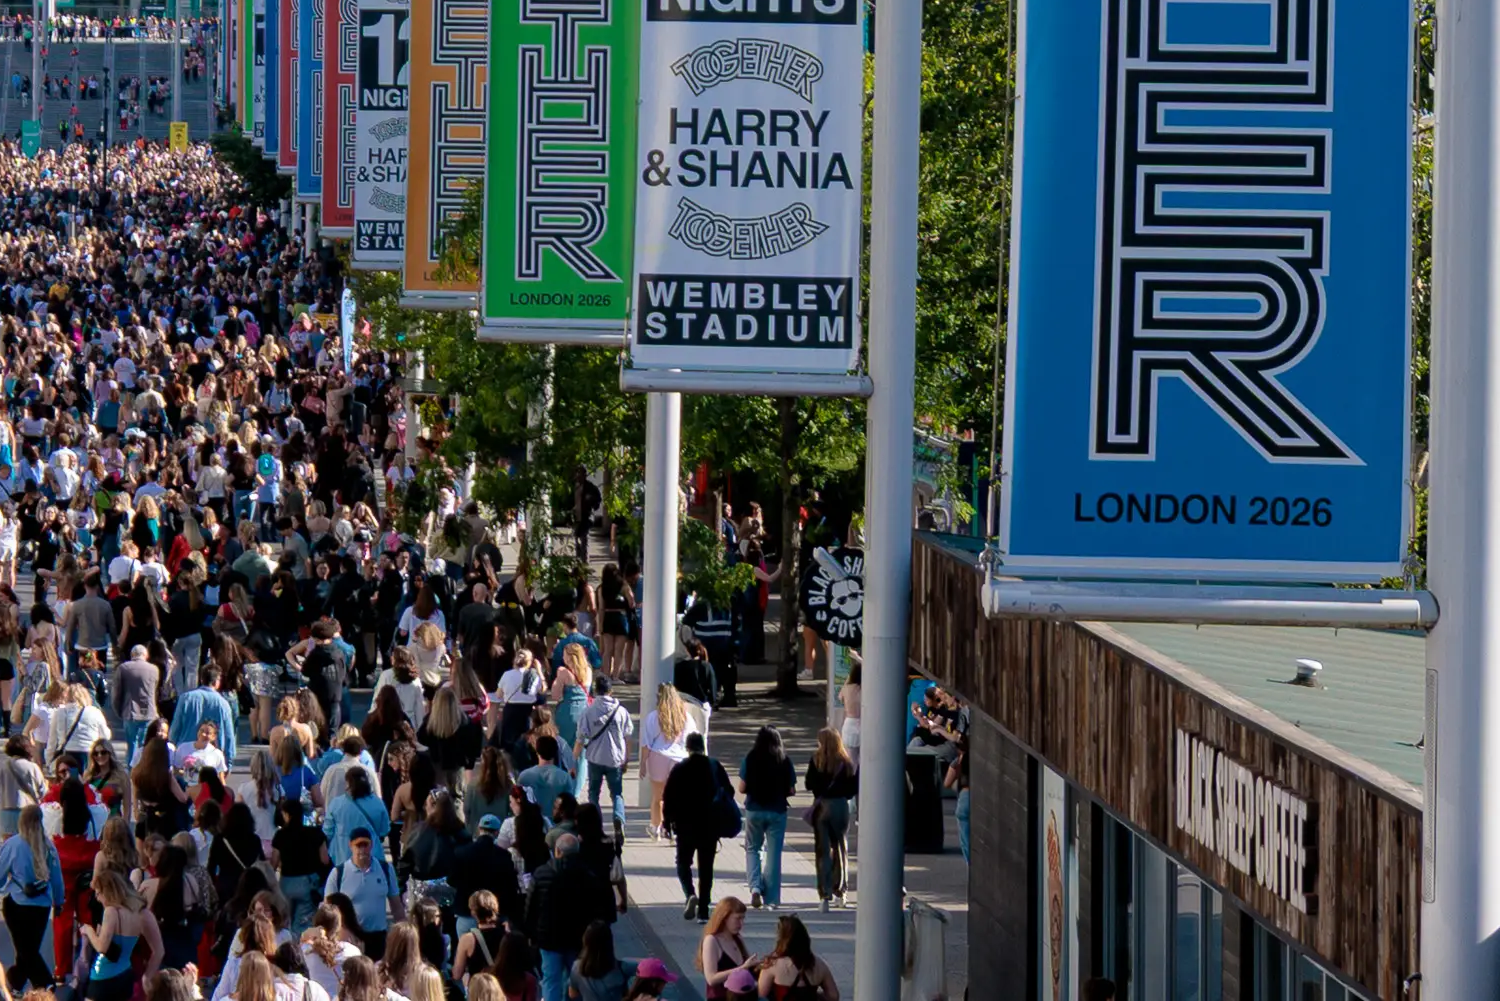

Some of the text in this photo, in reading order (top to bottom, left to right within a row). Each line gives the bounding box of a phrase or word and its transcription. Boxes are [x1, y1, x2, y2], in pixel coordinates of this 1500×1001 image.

[670, 38, 823, 104] TOGETHER
[669, 107, 831, 147] HARRY
[668, 196, 830, 260] TOGETHER
[510, 293, 611, 307] LONDON 2026
[646, 281, 846, 311] WEMBLEY
[645, 312, 845, 342] STADIUM
[1074, 493, 1333, 527] LONDON 2026
[1176, 728, 1307, 914] BLACK SHEEP COFFEE
